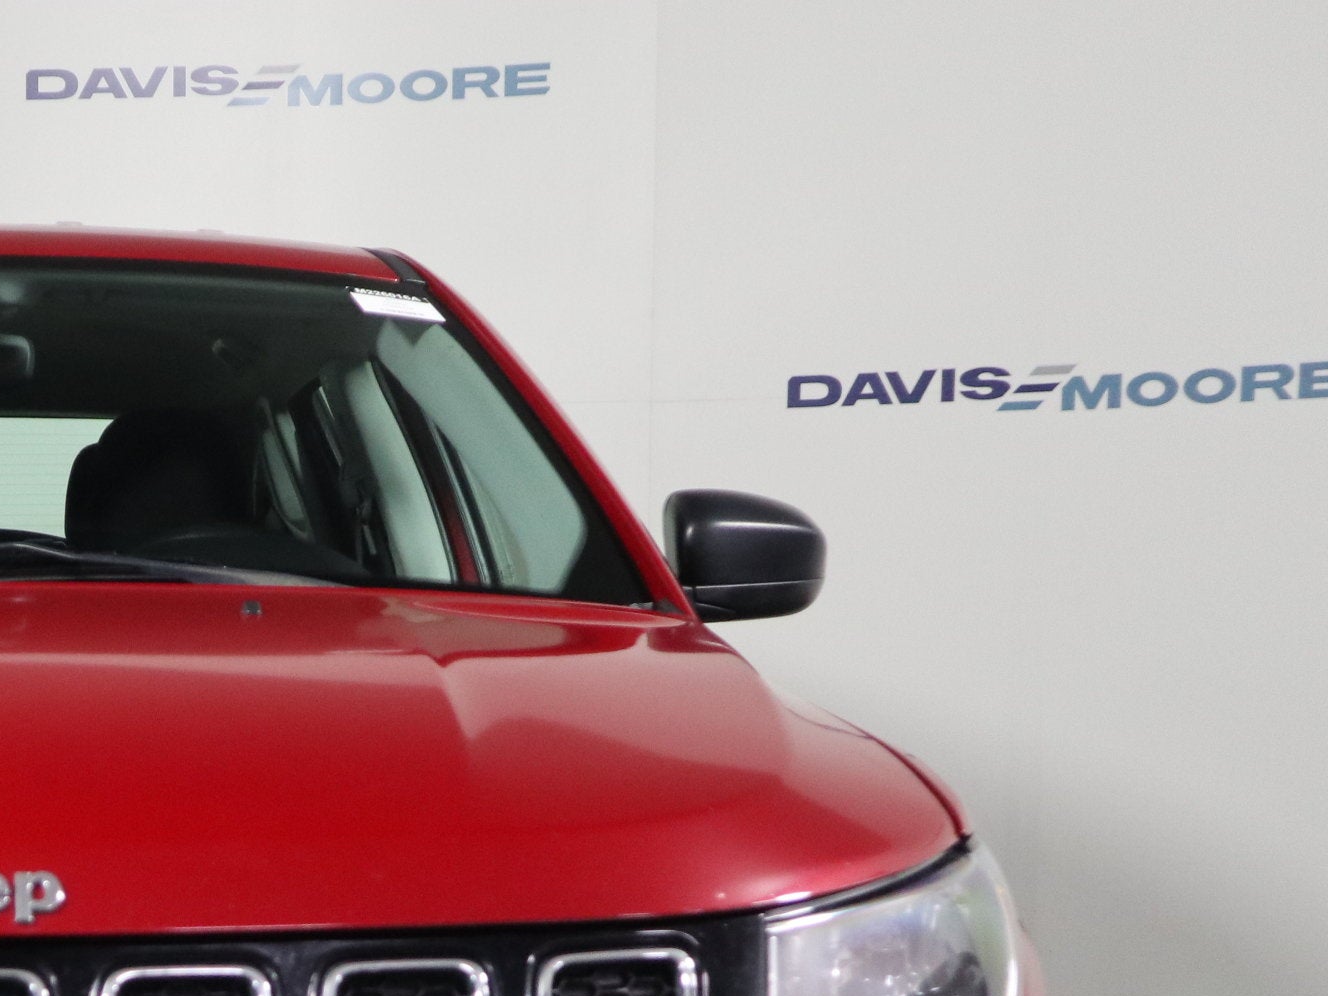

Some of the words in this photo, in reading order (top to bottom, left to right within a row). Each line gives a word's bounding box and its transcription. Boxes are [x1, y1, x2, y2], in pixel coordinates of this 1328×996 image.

[26, 64, 239, 101] DAVIS
[285, 62, 551, 107] MOORE
[786, 366, 1012, 408] DAVIS
[1060, 361, 1328, 411] MOORE
